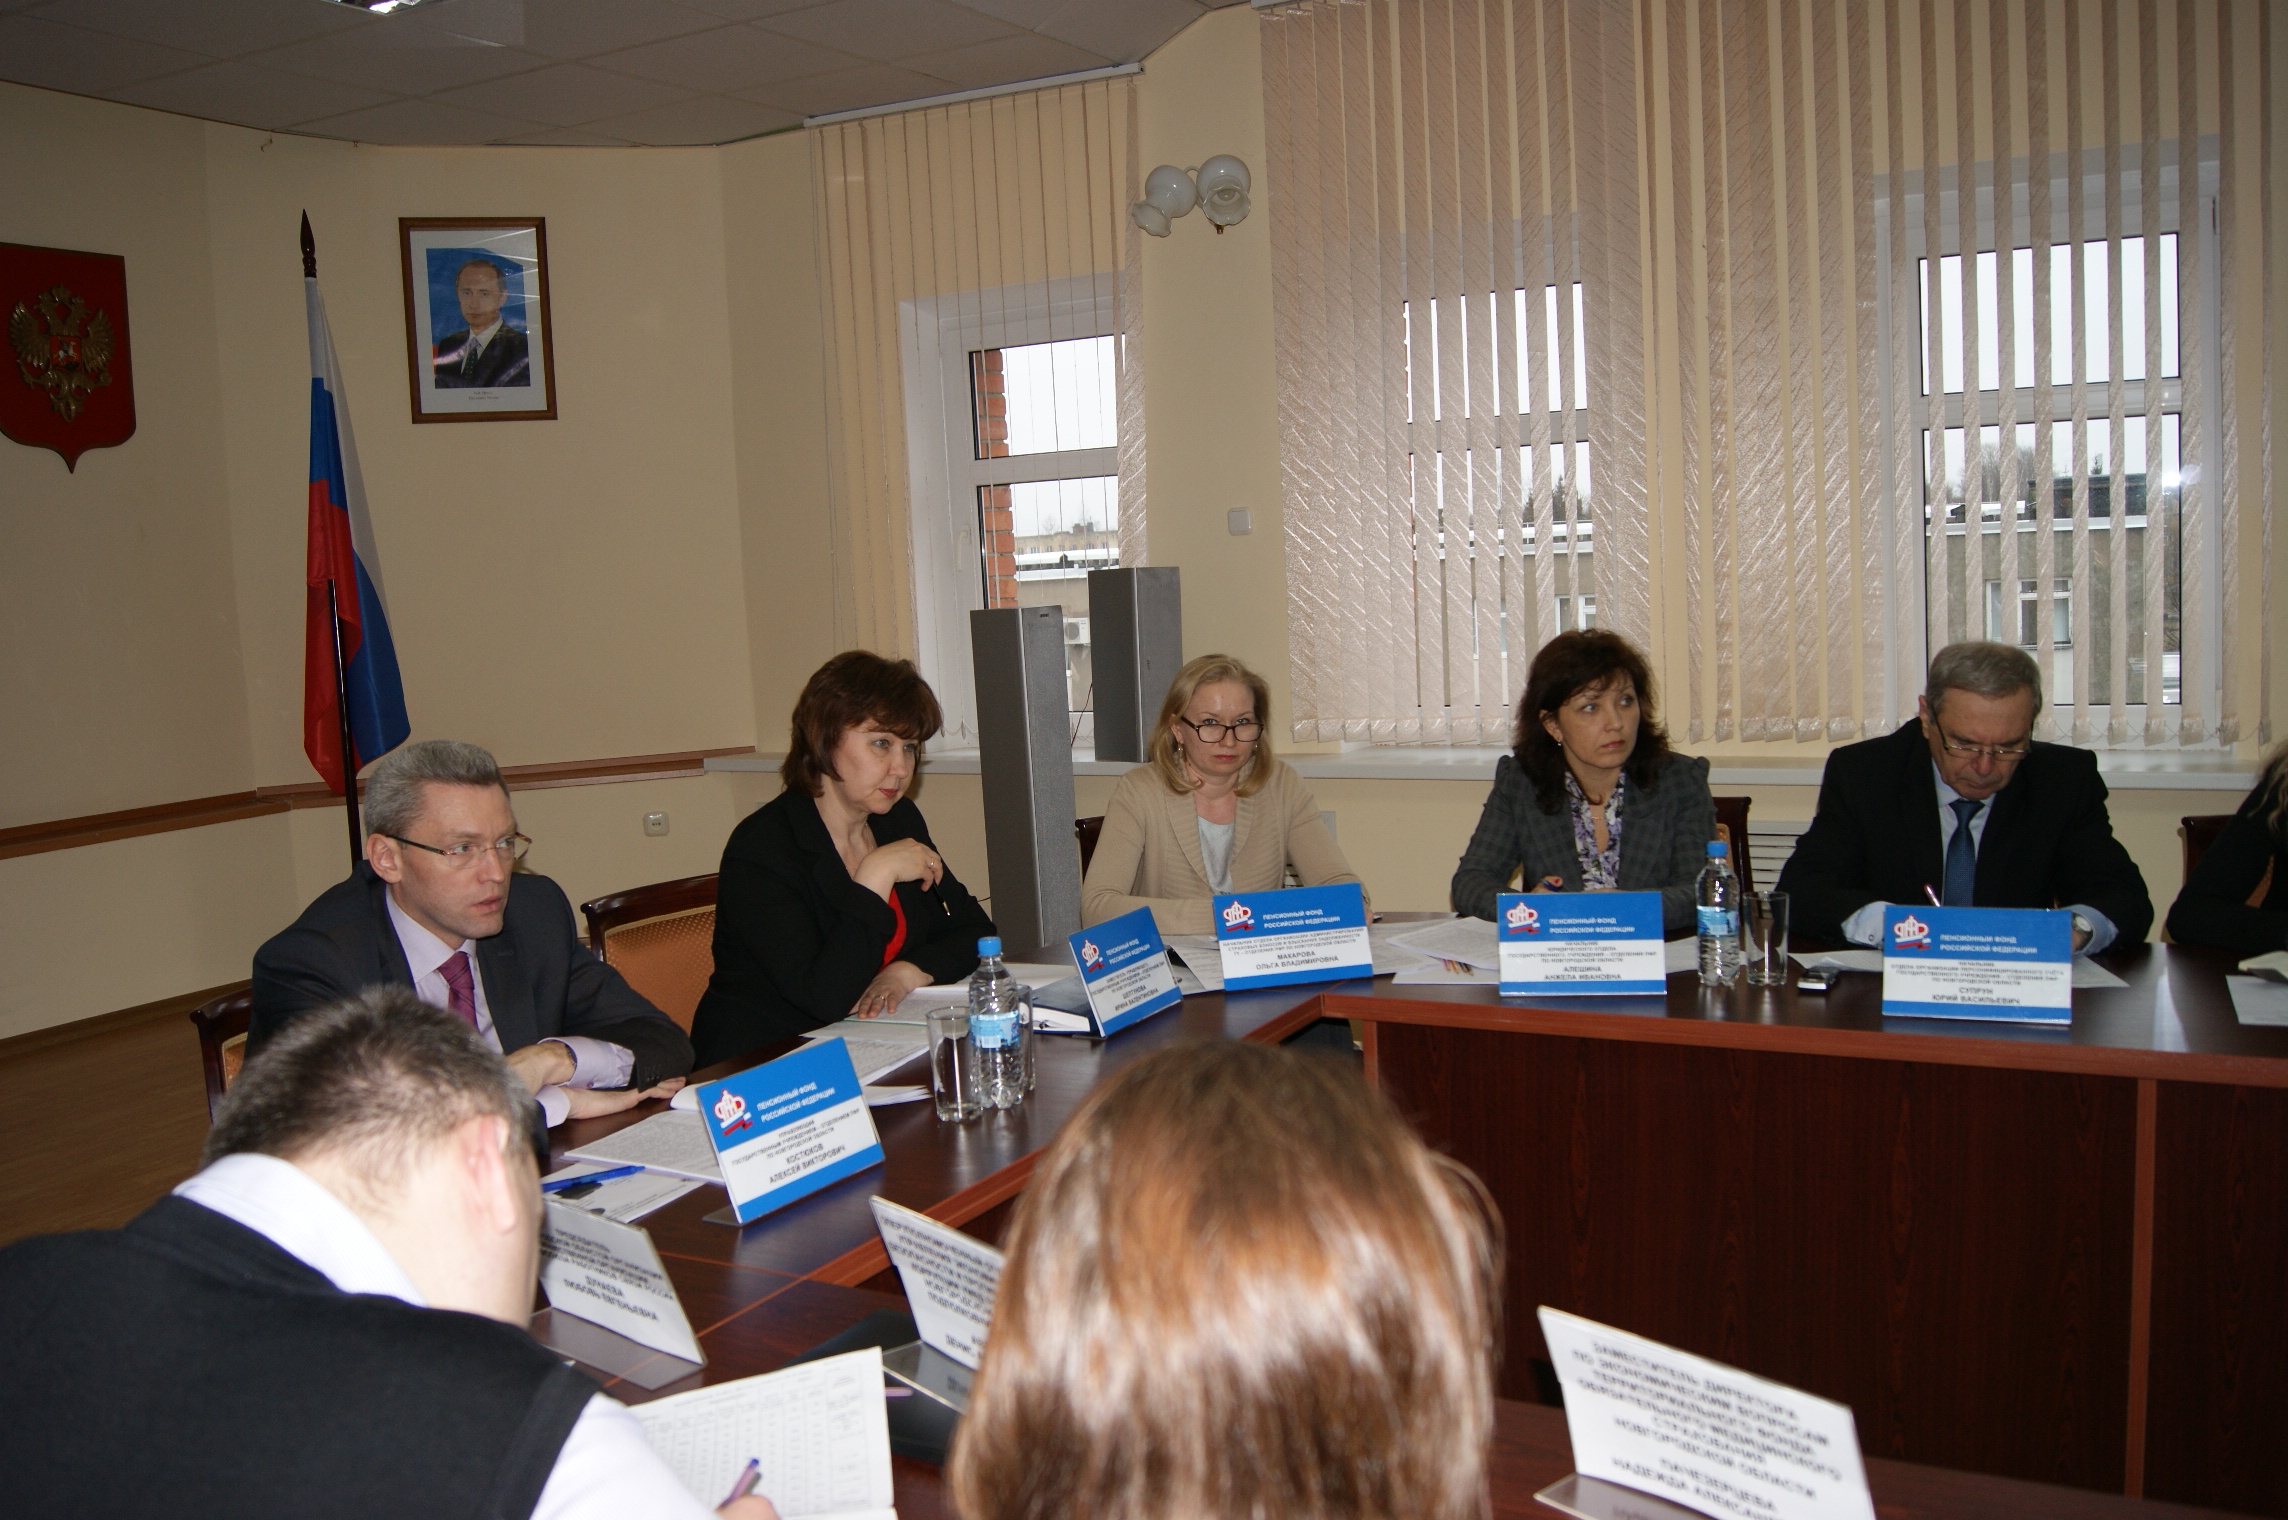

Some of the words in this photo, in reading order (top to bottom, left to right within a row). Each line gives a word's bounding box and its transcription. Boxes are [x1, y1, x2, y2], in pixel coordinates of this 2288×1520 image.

[1263, 911, 1304, 920] ПЕНСИОННЫЙ
[1264, 919, 1304, 928] РОССИЙСКОЙ
[1305, 916, 1340, 925] ФЕДЕРАЦИИ
[1940, 934, 1993, 942] ПЕНСИОННЫЙ
[1995, 936, 2016, 944] ФОНД
[1940, 944, 1990, 952] РОССИЙСКОЙ
[1992, 946, 2037, 954] ФЕДЕРАЦИИ
[1256, 962, 1279, 970] ОЛЬГА
[1281, 956, 1339, 967] ВЛАДИМИРОВНА
[1277, 951, 1316, 960] МАКАРОВА
[1932, 994, 1958, 1002] ЮРИЙ
[1961, 996, 2020, 1005] ВАСИЛЬЕВИЧ
[1959, 987, 1993, 995] СУПРУН
[756, 1088, 799, 1112] ПЕНСИОННЫЙ
[798, 1082, 817, 1096] ФОНД
[760, 1100, 801, 1123] РОССИЙСКОЙ
[800, 1087, 836, 1107] ФЕДЕРАЦИИ
[768, 1163, 801, 1185] АЛЕКСЕЙ
[801, 1144, 846, 1170] ВИКТОРОВИЧ
[785, 1143, 824, 1165] КОСТЮКОВ
[1591, 1341, 1699, 1387] ЗАМЕСТИТЕЛЬ
[1702, 1377, 1798, 1421] ДИРЕКТОРА
[1572, 1349, 1595, 1367] ПО
[1599, 1358, 1734, 1413] ЭКОНОМИЧЕСКИМ
[1737, 1405, 1830, 1448] ВОПРОСАМ
[1592, 1369, 1753, 1434] ТЕРРИТОРИАЛЬНОГО
[1756, 1426, 1814, 1457] ФОНДА
[1577, 1378, 1707, 1430] ОБЯЗАТЕЛЬНОГО
[1709, 1423, 1843, 1483] МЕДИЦИНСКОГО
[1651, 1416, 1766, 1465] СТРАХОВАНИЯ
[1613, 1416, 1736, 1469] НОВГОРОДСКОЙ
[1739, 1462, 1817, 1500] ОБЛАСТИ
[1611, 1456, 1689, 1492] НАДЕЖДА
[1694, 1485, 1782, 1520] АЛЕКСАН
